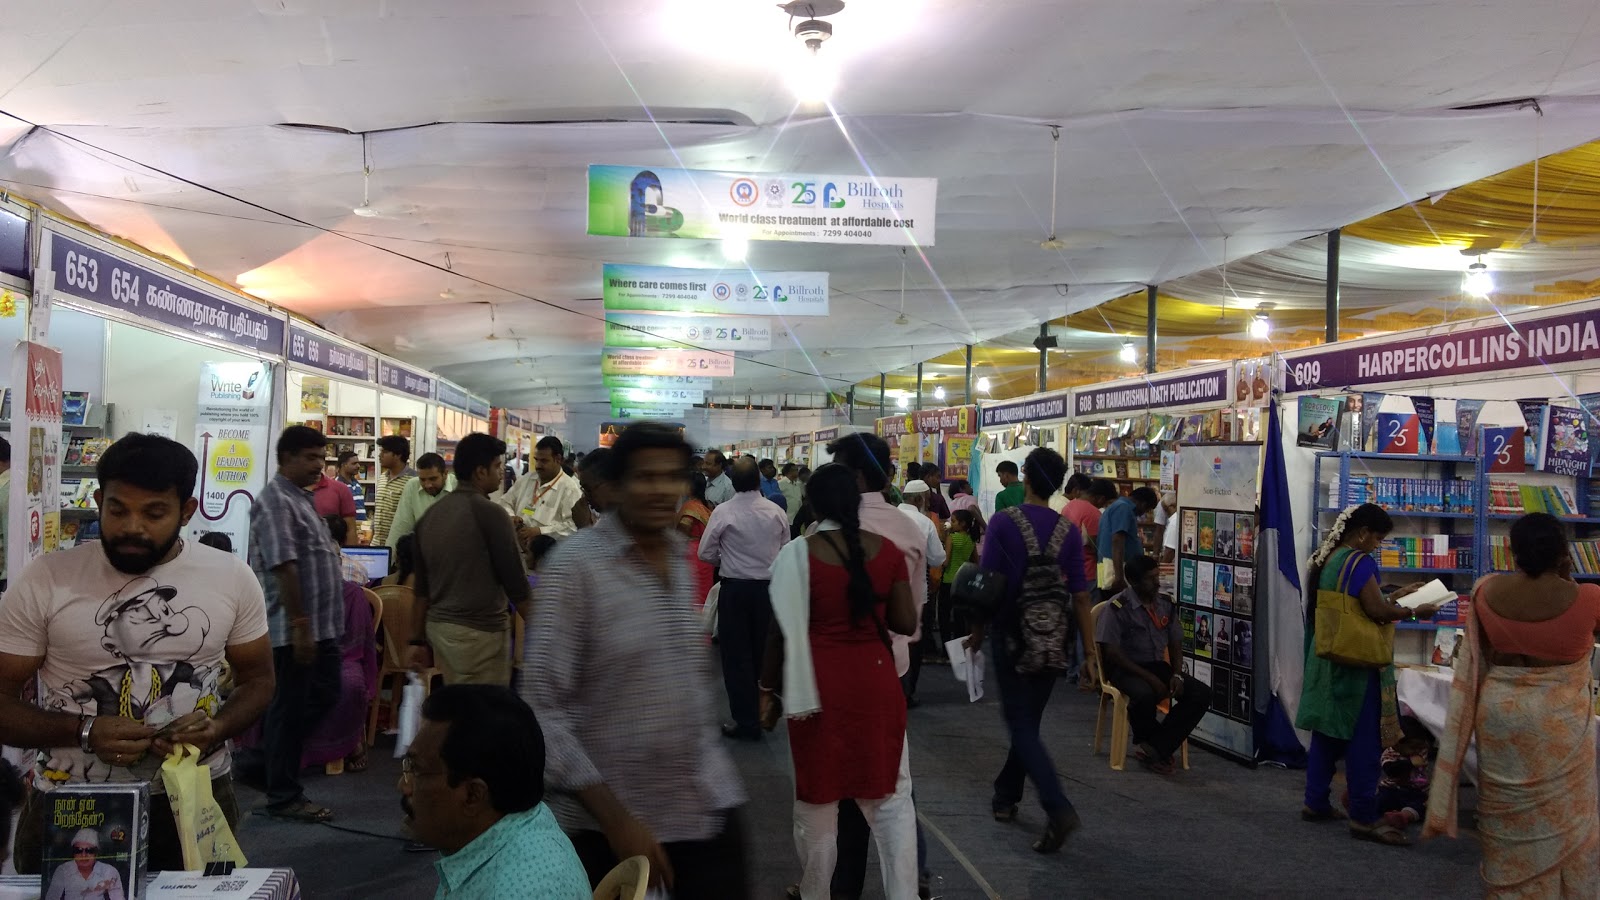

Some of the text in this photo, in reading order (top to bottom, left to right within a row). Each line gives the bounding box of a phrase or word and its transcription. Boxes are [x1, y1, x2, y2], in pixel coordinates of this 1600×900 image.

[791, 182, 816, 205] 25
[848, 182, 903, 198] Billroth
[863, 199, 904, 210] Hospitals
[719, 213, 914, 229] World class treatment at affordable cost
[844, 230, 872, 238] 404040
[65, 250, 140, 307] 653 654
[609, 278, 707, 291] Where care comes first
[753, 285, 768, 299] 25
[788, 285, 824, 295] Billroth
[146, 283, 268, 344] கண்ணதாசன் பதிப்பகம்
[716, 328, 727, 339] 25
[742, 327, 768, 336] Billroth
[292, 334, 305, 358] 655
[1294, 320, 1600, 386] 609 HARPERCOLLINS INDIA
[211, 380, 242, 392] Write
[210, 391, 241, 401] Publishing
[1080, 377, 1219, 412] 608 SRI RAMAKRISHNA MATH PUBLICATION
[218, 429, 250, 440] BECOME
[1388, 420, 1409, 447] 25
[229, 444, 235, 454] A
[1493, 435, 1513, 465] 25
[216, 457, 250, 468] LEADING
[216, 471, 248, 482] AUTHOR
[1555, 466, 1578, 477] GANG
[206, 492, 225, 500] 1400
[54, 796, 96, 813] நான் ஏன்
